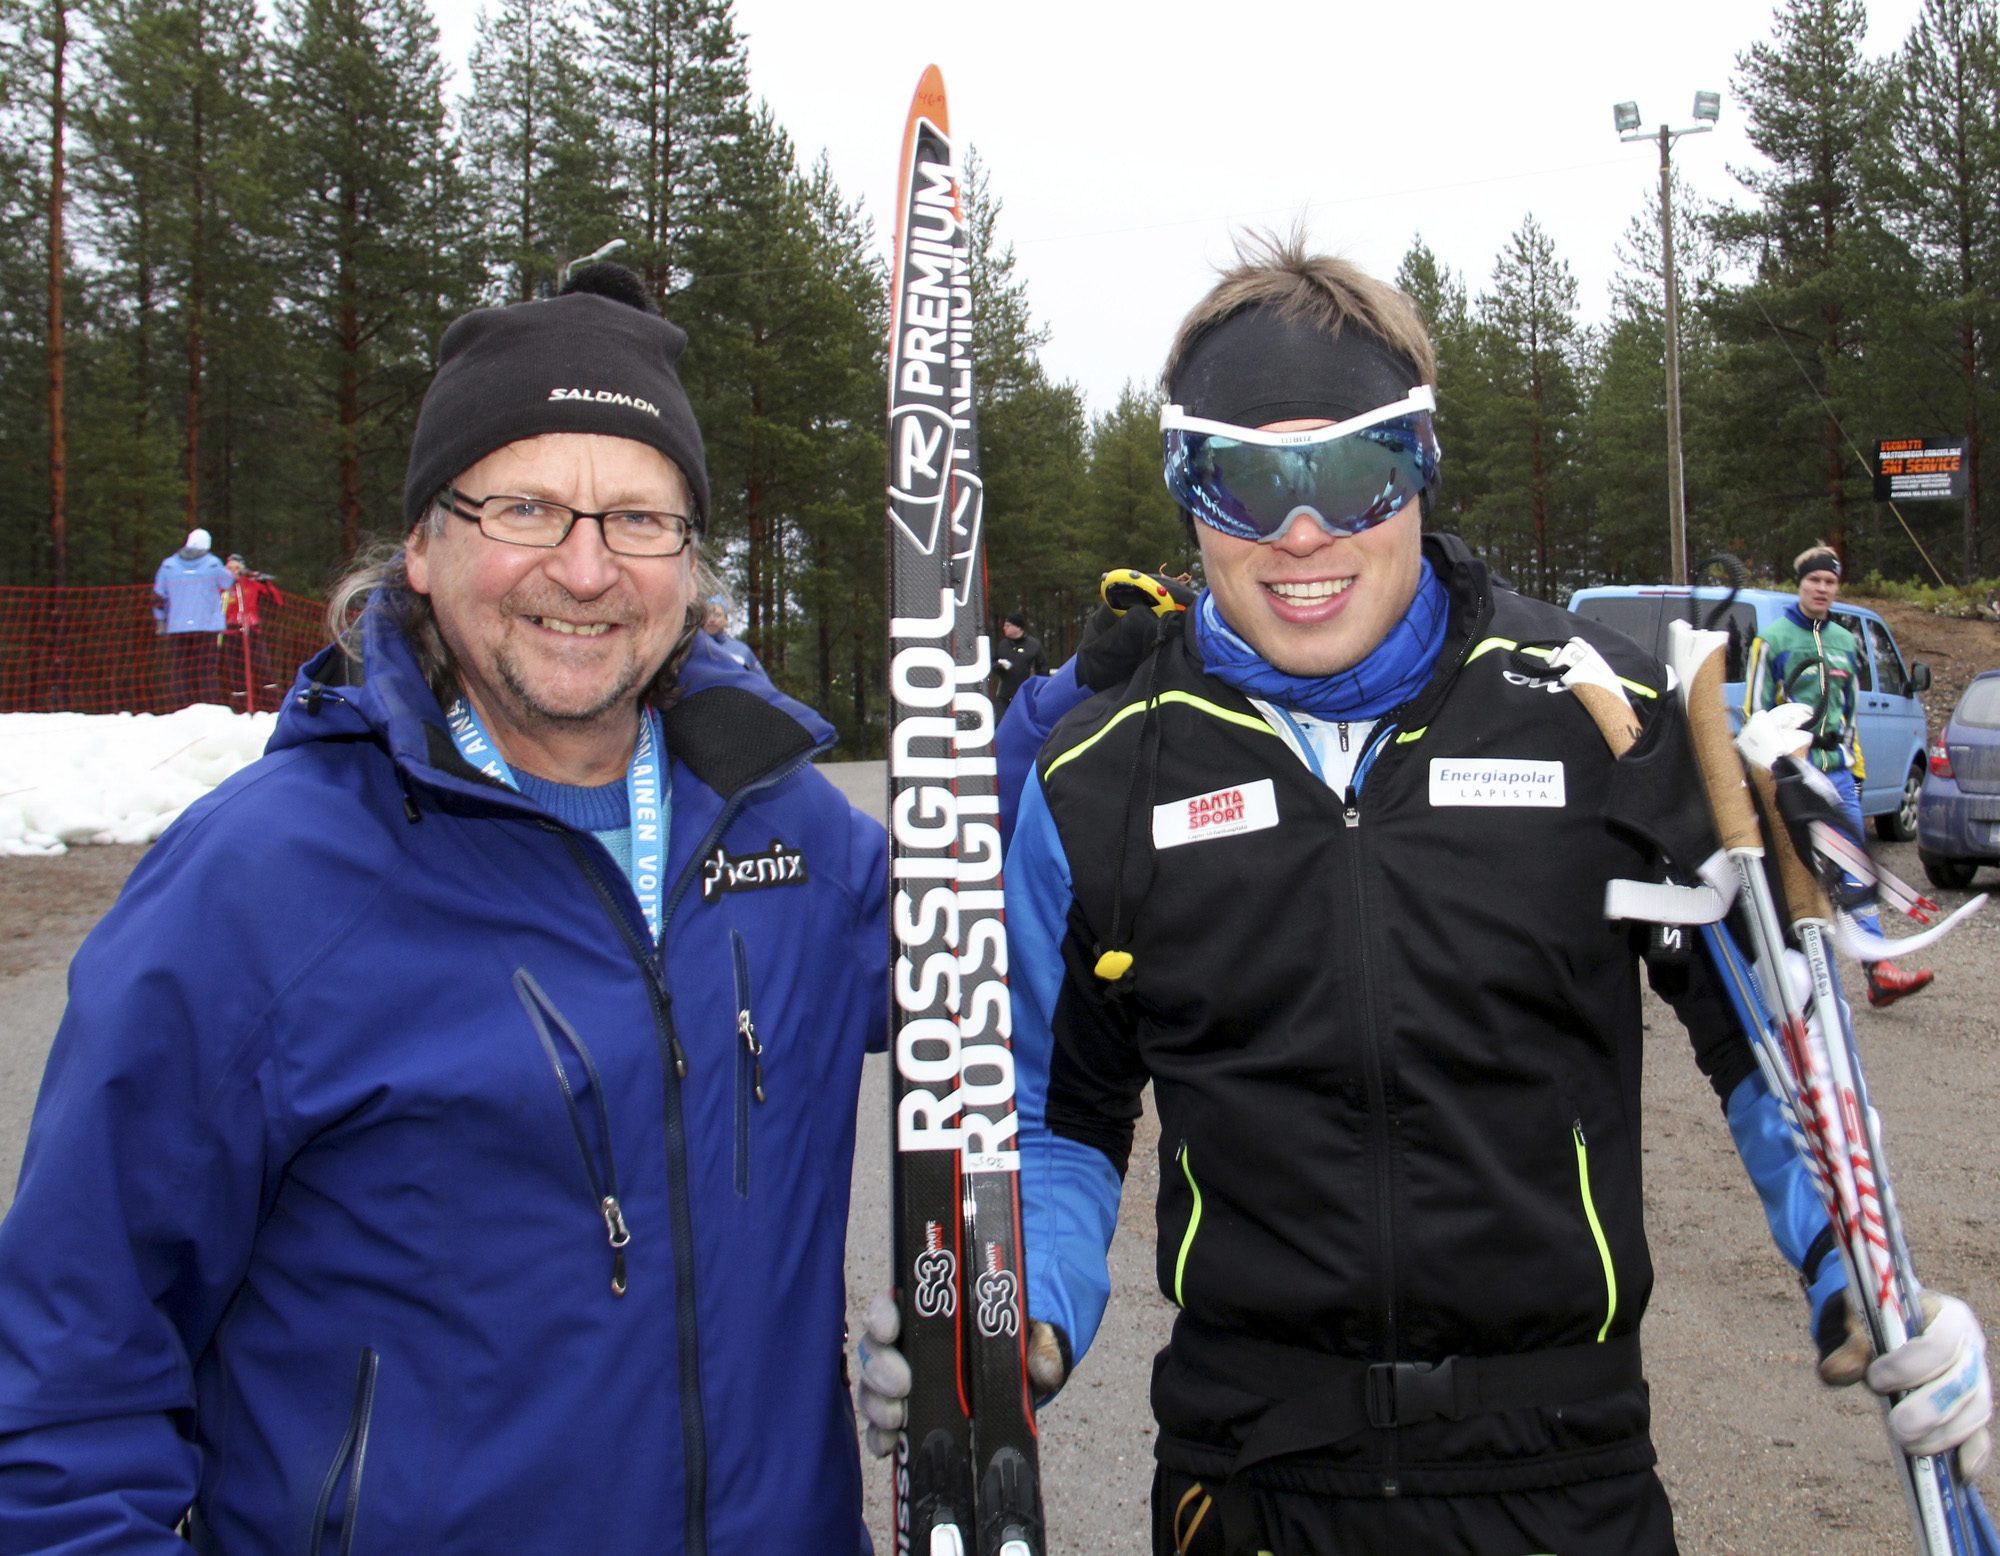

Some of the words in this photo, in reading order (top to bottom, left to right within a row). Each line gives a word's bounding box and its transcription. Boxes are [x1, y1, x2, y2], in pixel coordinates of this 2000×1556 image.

[901, 161, 955, 396] PREMIUM
[548, 388, 661, 417] SALOMON
[1881, 459, 1904, 475] SKI
[1905, 456, 1961, 473] SERVICE
[1188, 789, 1244, 815] SANTA
[1440, 769, 1556, 784] Energiapolar
[1188, 804, 1245, 830] SPORT
[703, 843, 804, 896] phenix
[889, 587, 963, 1152] ROSSIGNOL
[637, 854, 659, 947] VOITT
[914, 1249, 957, 1318] S3
[975, 1269, 1020, 1338] S3
